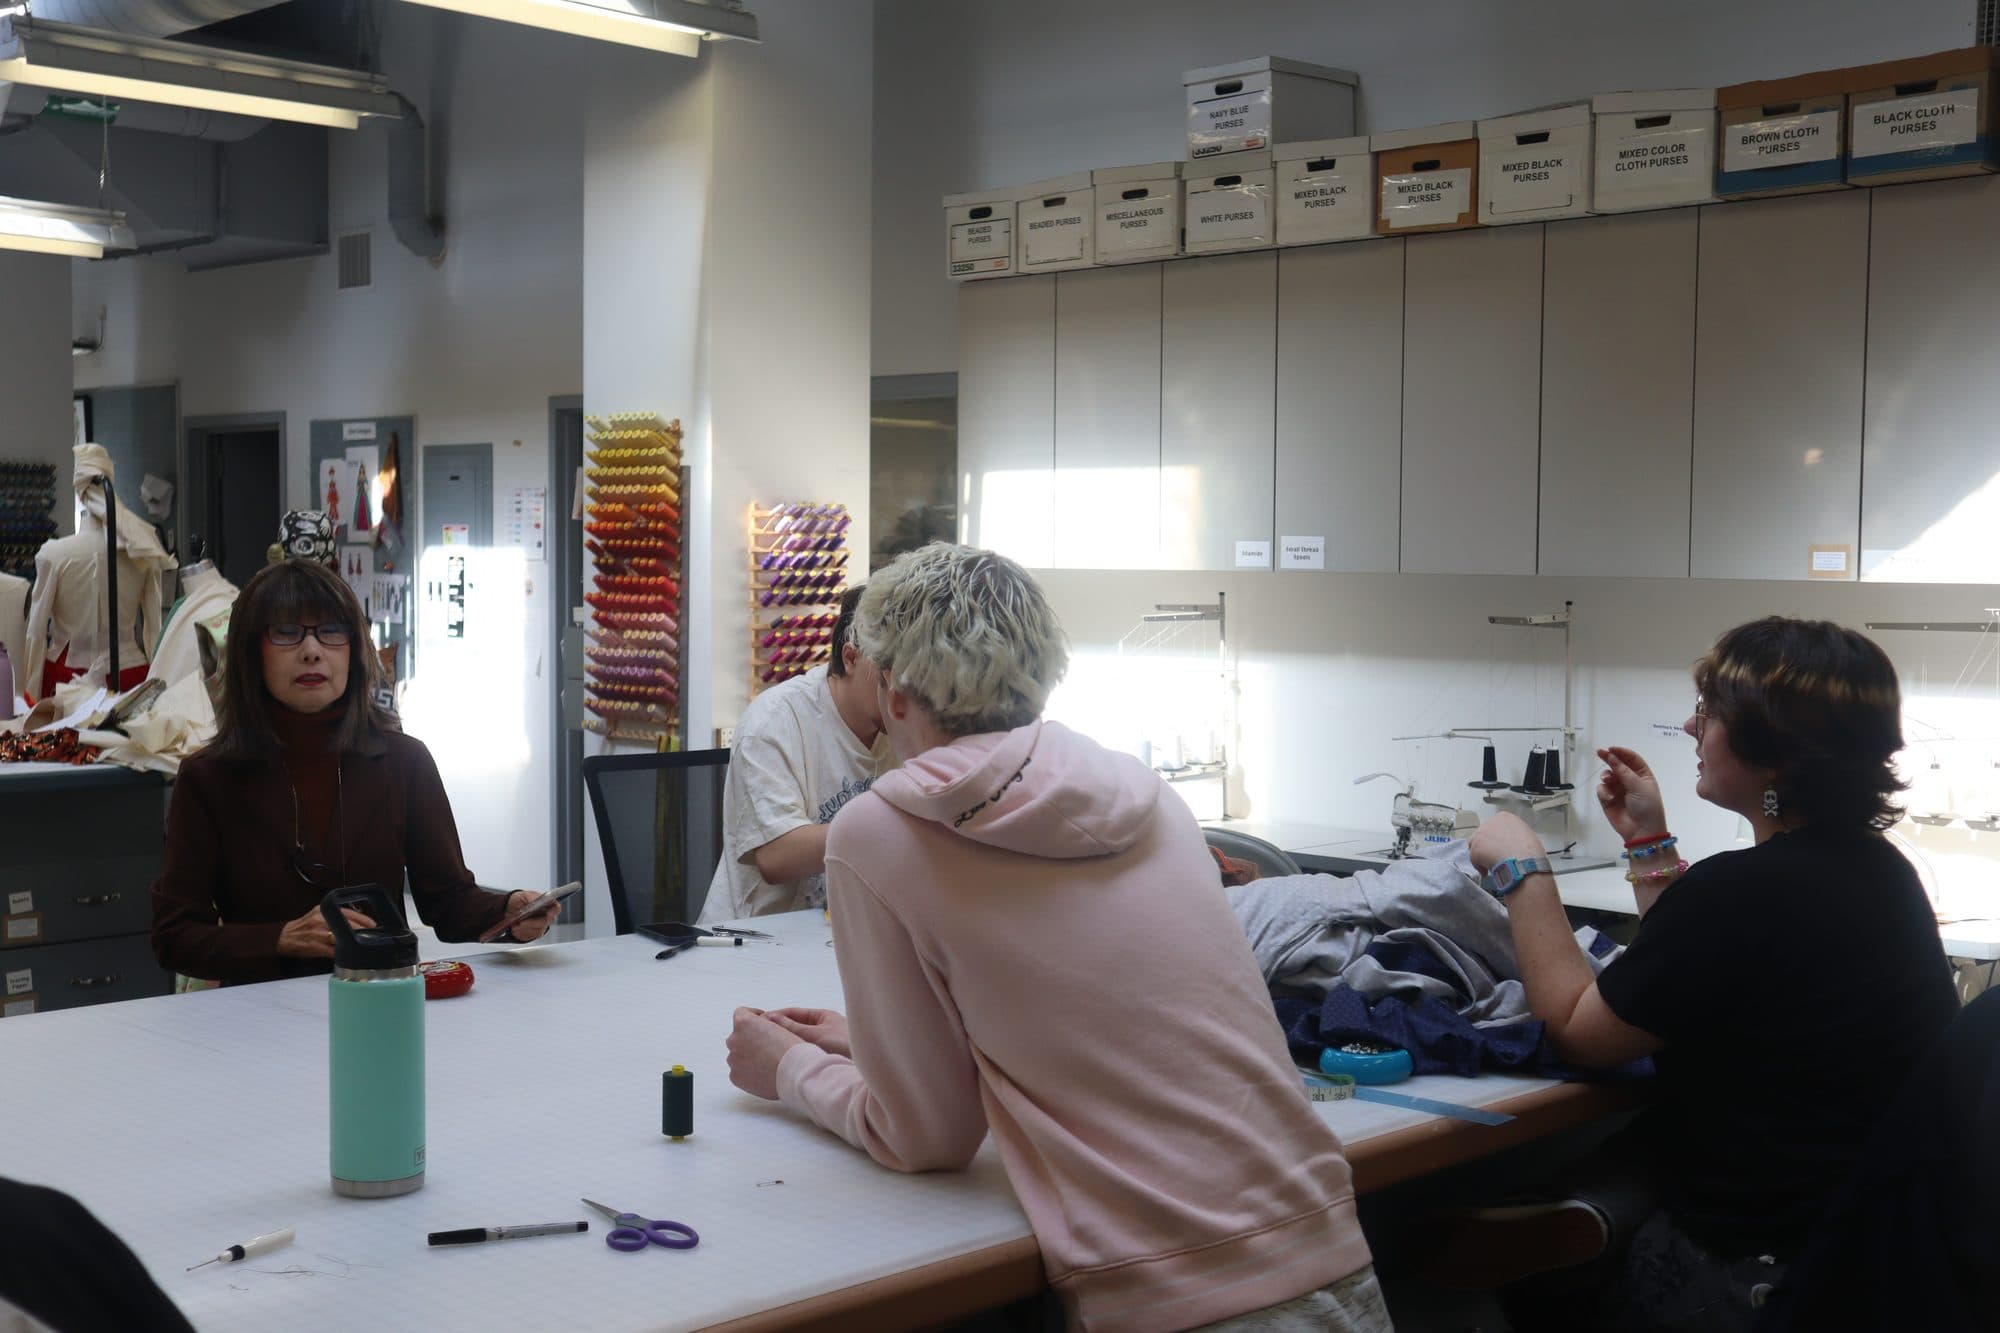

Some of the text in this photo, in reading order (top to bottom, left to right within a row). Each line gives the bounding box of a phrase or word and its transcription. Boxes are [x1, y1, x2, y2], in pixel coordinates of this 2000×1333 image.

[1209, 105, 1249, 120] NAVY BLUE
[1873, 104, 1955, 125] BLACK CLOTH
[1214, 118, 1244, 130] PURSES
[1890, 120, 1937, 136] PURSES
[1741, 126, 1820, 145] BROWN CLOTH
[1618, 143, 1686, 160] MIXED COLOR
[1758, 141, 1801, 156] PURSES
[1502, 158, 1563, 173] MIXED BLACK
[1615, 155, 1689, 172] CLOTH PURSES
[1513, 171, 1550, 183] PURSES
[1294, 185, 1348, 200] MIXED BLACK
[1397, 181, 1454, 193] MIXED BLACK
[1304, 198, 1336, 209] PURSES
[1408, 193, 1442, 204] PURSES
[1106, 207, 1164, 221] MISCELLANEOUS
[1200, 211, 1255, 224] WHITE PURSES
[967, 225, 992, 235] BEADED
[1029, 216, 1081, 230] BEADED PURSES
[1120, 219, 1148, 230] PURSES
[967, 235, 992, 244] PURSES
